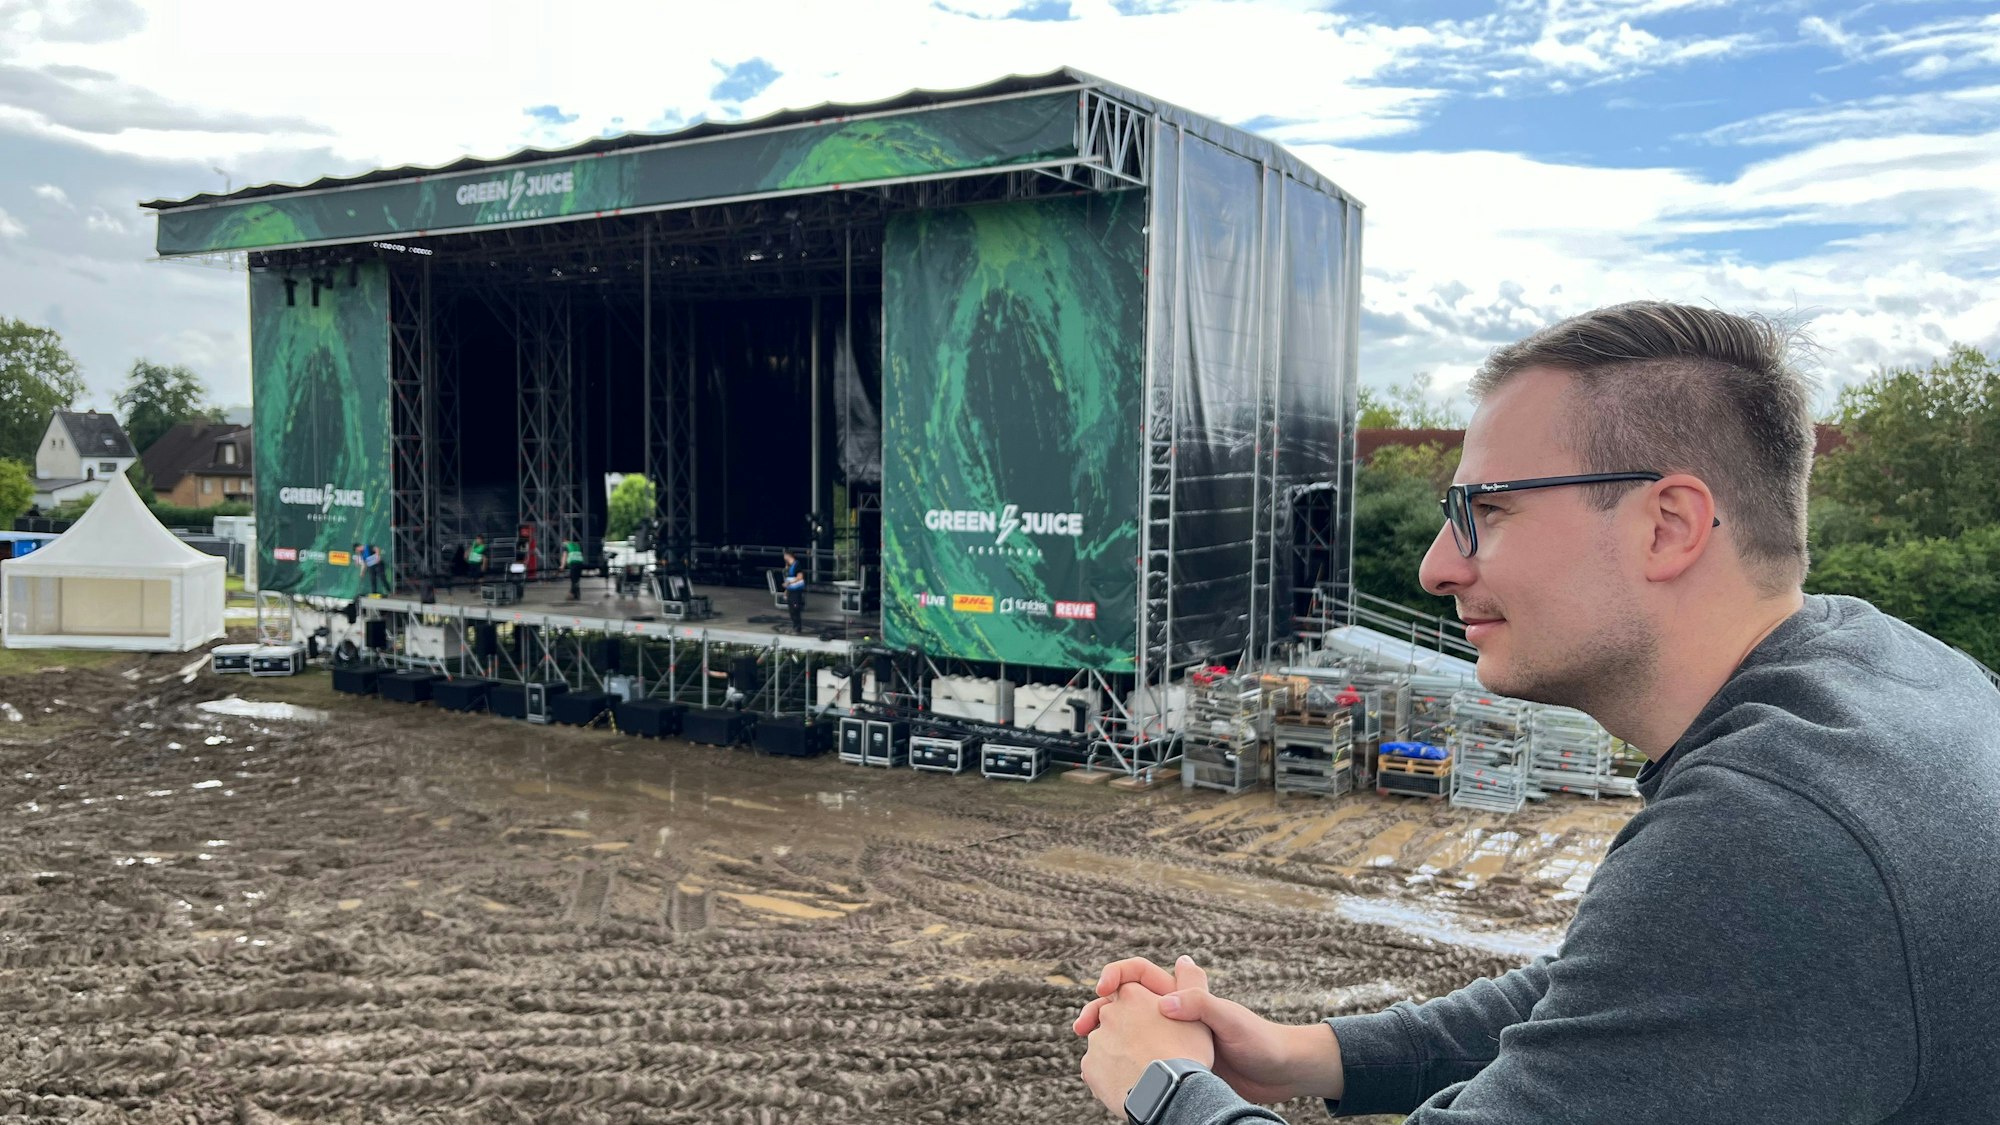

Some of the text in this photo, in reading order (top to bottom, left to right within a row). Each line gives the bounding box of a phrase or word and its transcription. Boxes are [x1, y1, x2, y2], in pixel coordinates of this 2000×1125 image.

[456, 171, 574, 205] GREEN JUICE
[280, 486, 364, 507] GREEN JUICE
[925, 509, 1083, 535] GREEN JUICE
[968, 545, 1043, 558] FESTIVAL
[959, 596, 987, 605] DHL
[1056, 602, 1094, 618] REWE
